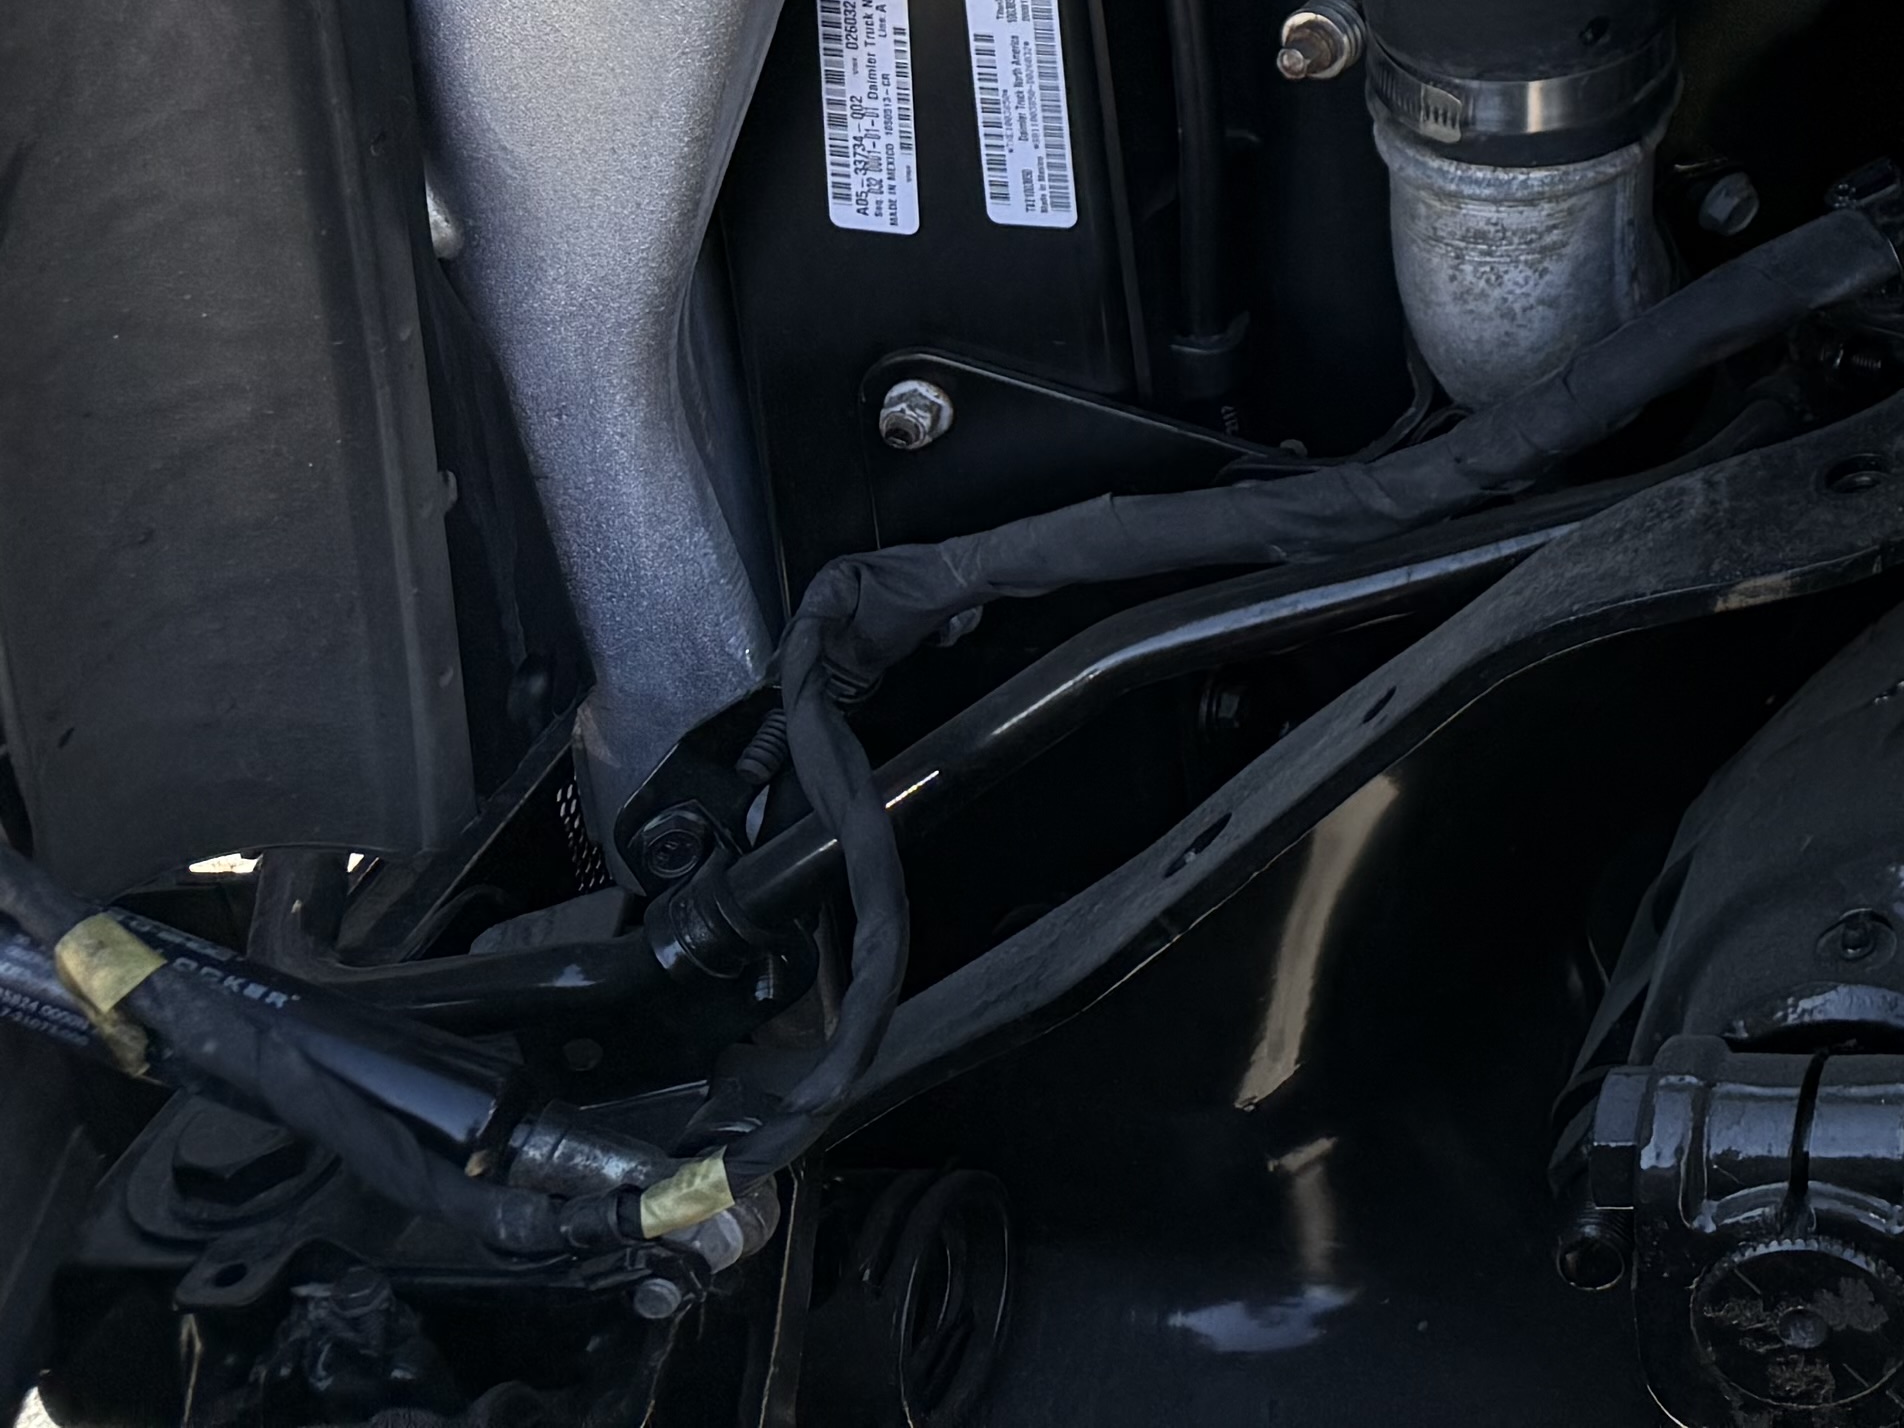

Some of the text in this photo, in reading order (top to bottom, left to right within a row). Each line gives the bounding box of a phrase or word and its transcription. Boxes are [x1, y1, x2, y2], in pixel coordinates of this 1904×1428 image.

[862, 11, 876, 48] Truck
[875, 3, 887, 13] A
[866, 52, 879, 101] Daimler
[1009, 35, 1029, 142] Daimler Truck North America
[884, 143, 899, 226] MADE IN MEXICO
